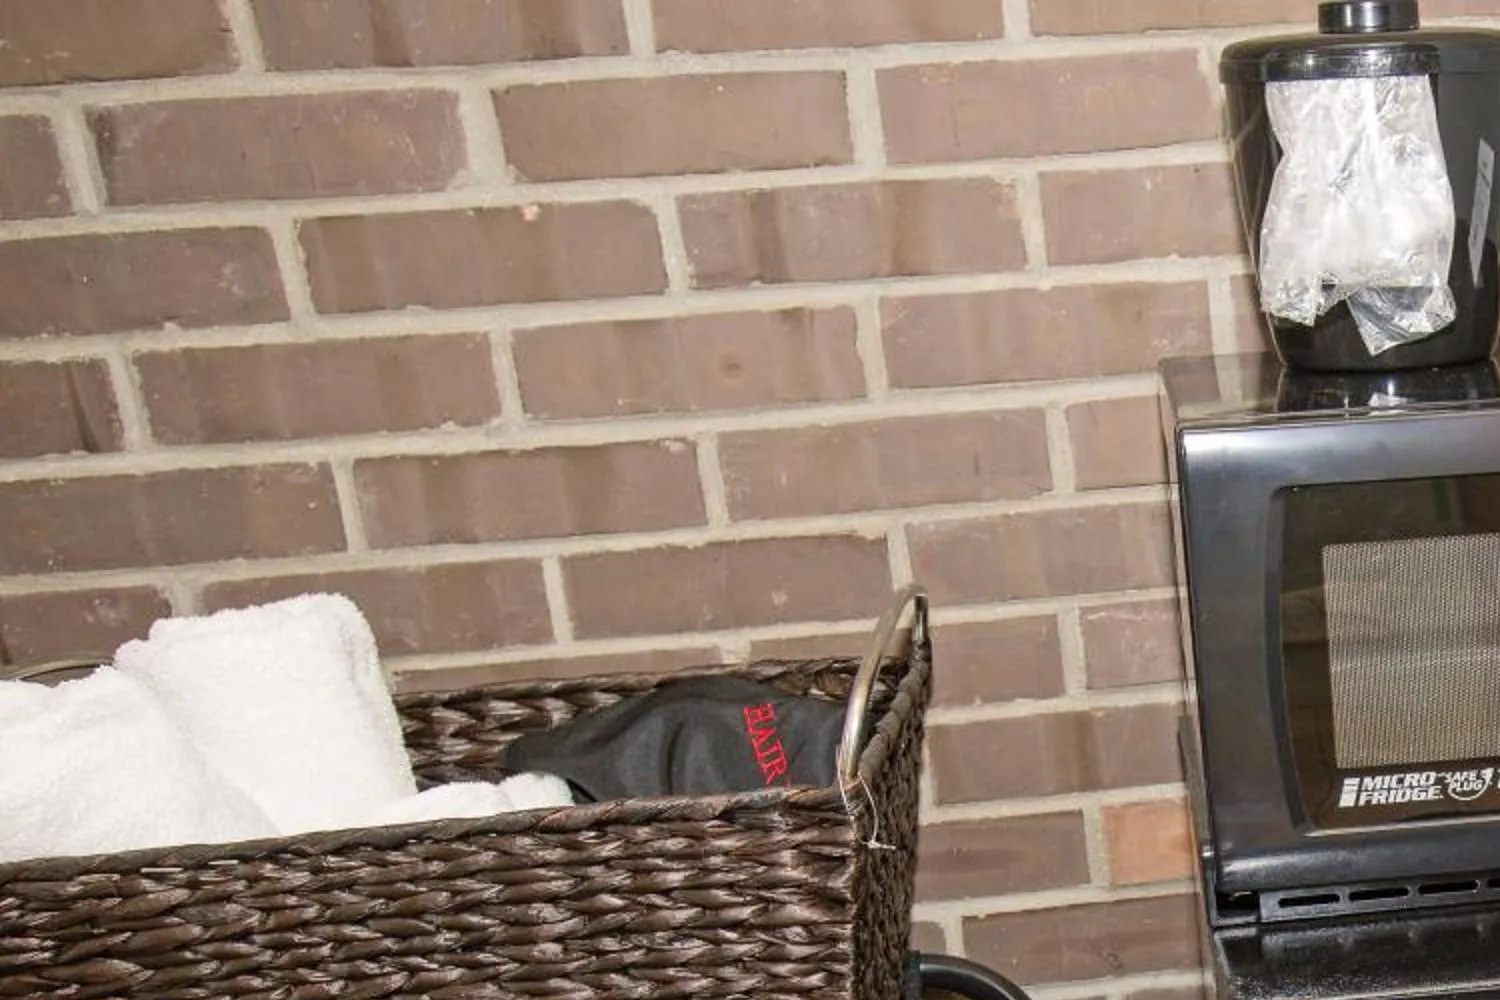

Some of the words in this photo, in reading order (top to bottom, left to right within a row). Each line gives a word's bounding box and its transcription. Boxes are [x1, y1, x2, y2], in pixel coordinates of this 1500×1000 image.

[742, 703, 788, 787] HAIR
[1357, 785, 1442, 807] FRIDGE
[1450, 779, 1484, 793] PLUG
[1361, 771, 1437, 791] MICRO
[1444, 769, 1477, 783] SAFE
